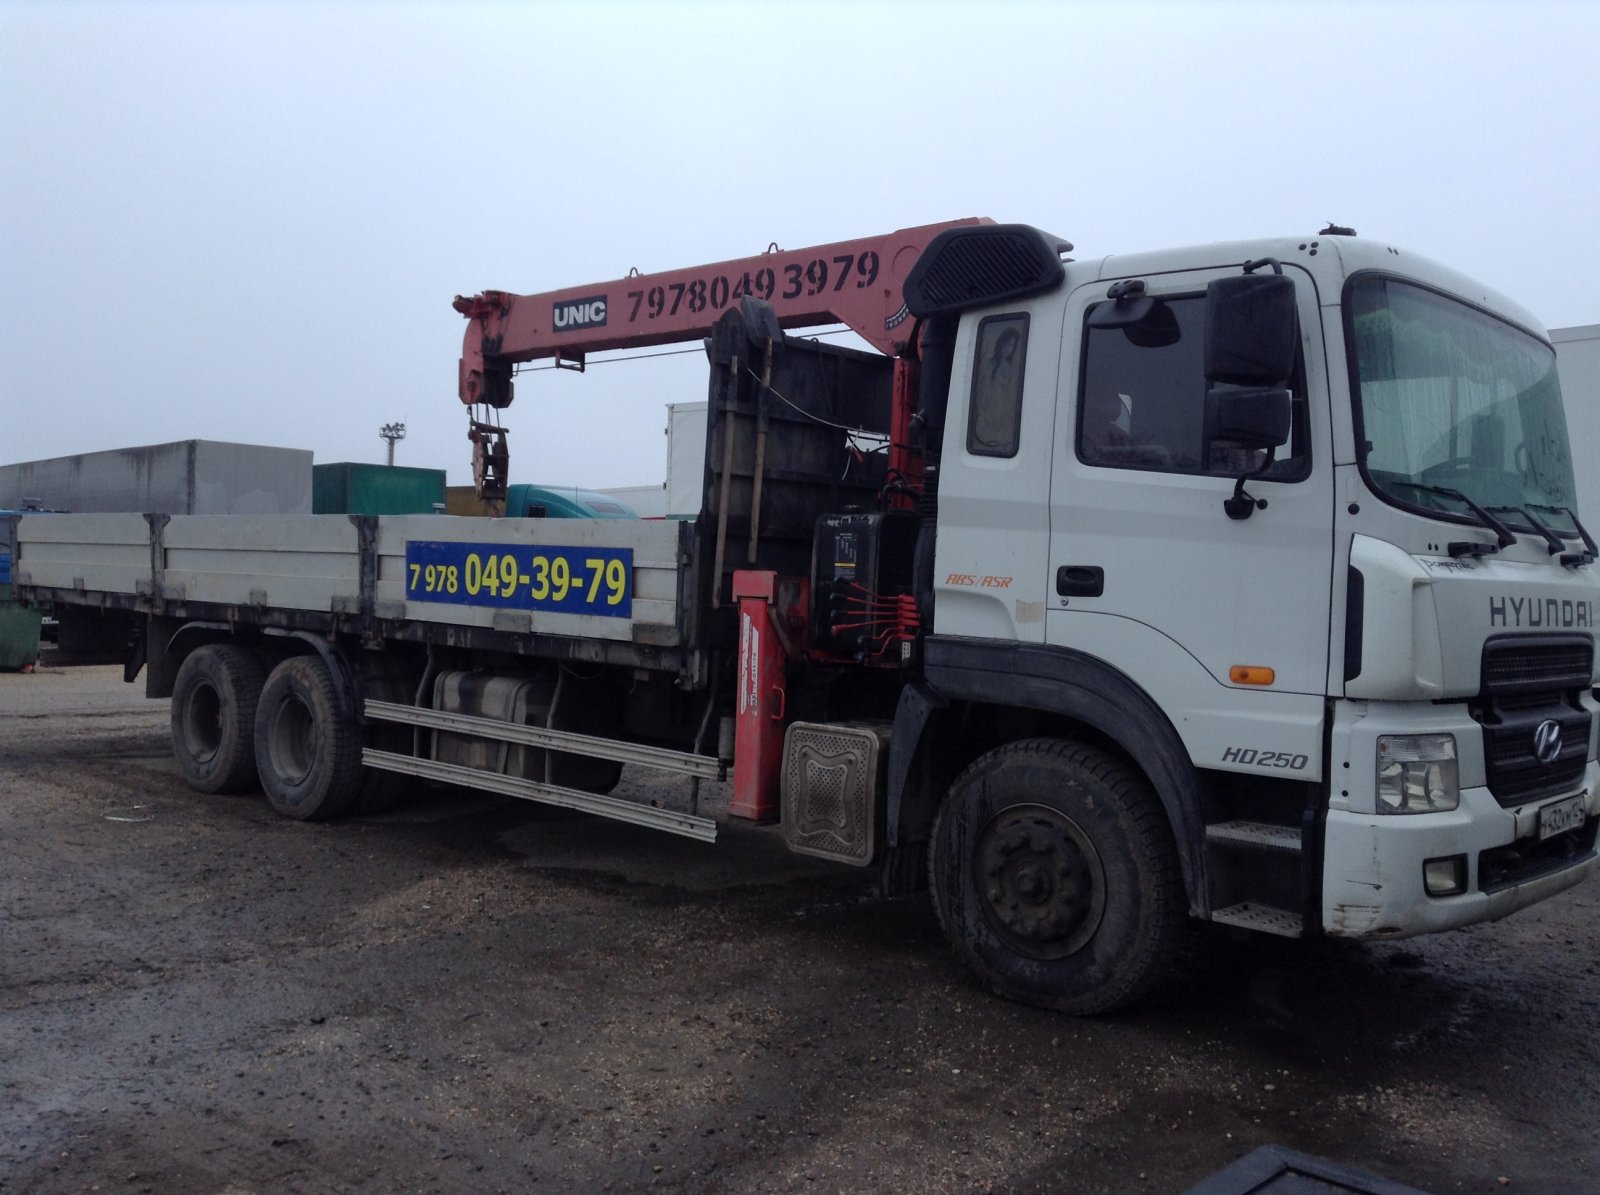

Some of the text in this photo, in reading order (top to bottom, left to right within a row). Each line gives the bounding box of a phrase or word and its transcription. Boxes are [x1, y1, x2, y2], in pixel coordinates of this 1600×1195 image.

[553, 301, 606, 327] UNIC
[409, 553, 626, 605] 7 978 049-39-79
[945, 572, 1014, 589] ABS/ASR
[1489, 596, 1593, 628] HYUNDAI
[1222, 746, 1309, 771] HD250
